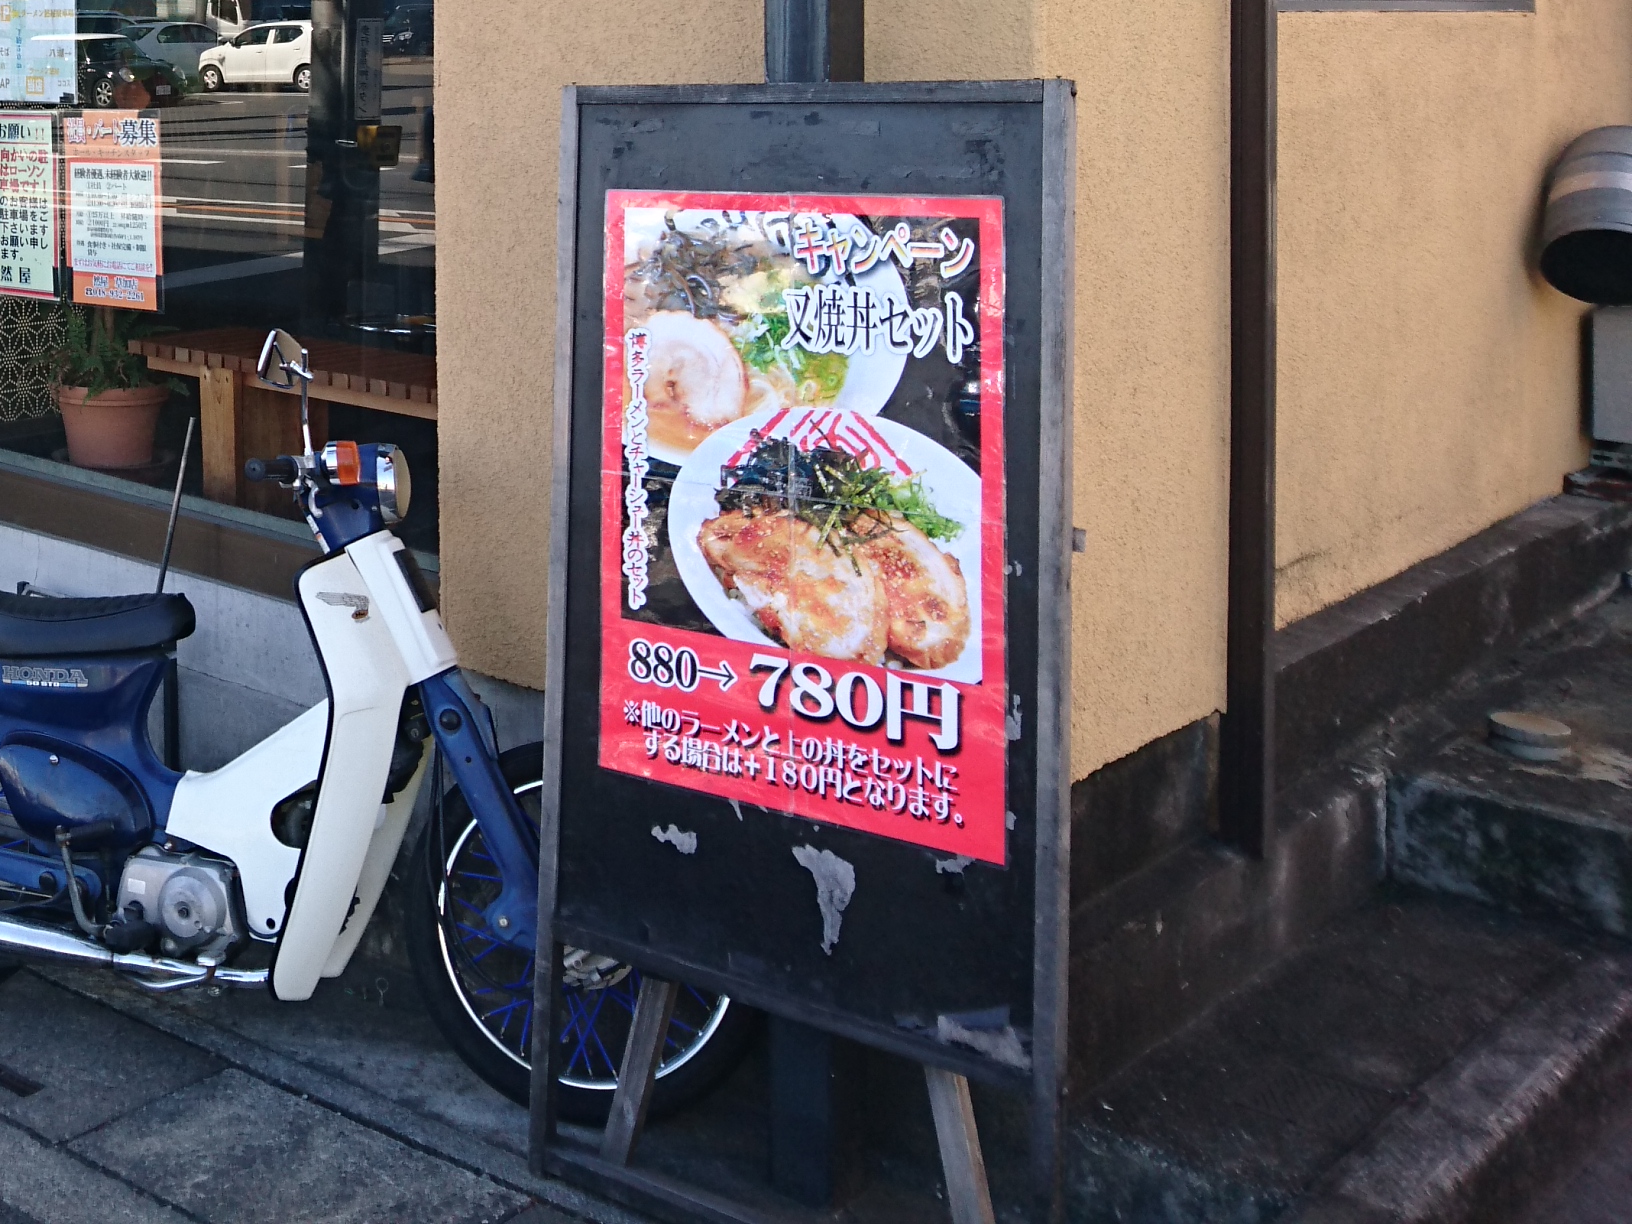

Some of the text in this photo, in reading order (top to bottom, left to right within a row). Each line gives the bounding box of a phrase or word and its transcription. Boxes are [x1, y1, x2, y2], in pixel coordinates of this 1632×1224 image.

[793, 222, 975, 278] キャンペーン
[782, 285, 975, 364] 叉焼丼セット
[2, 665, 88, 684] HONDA
